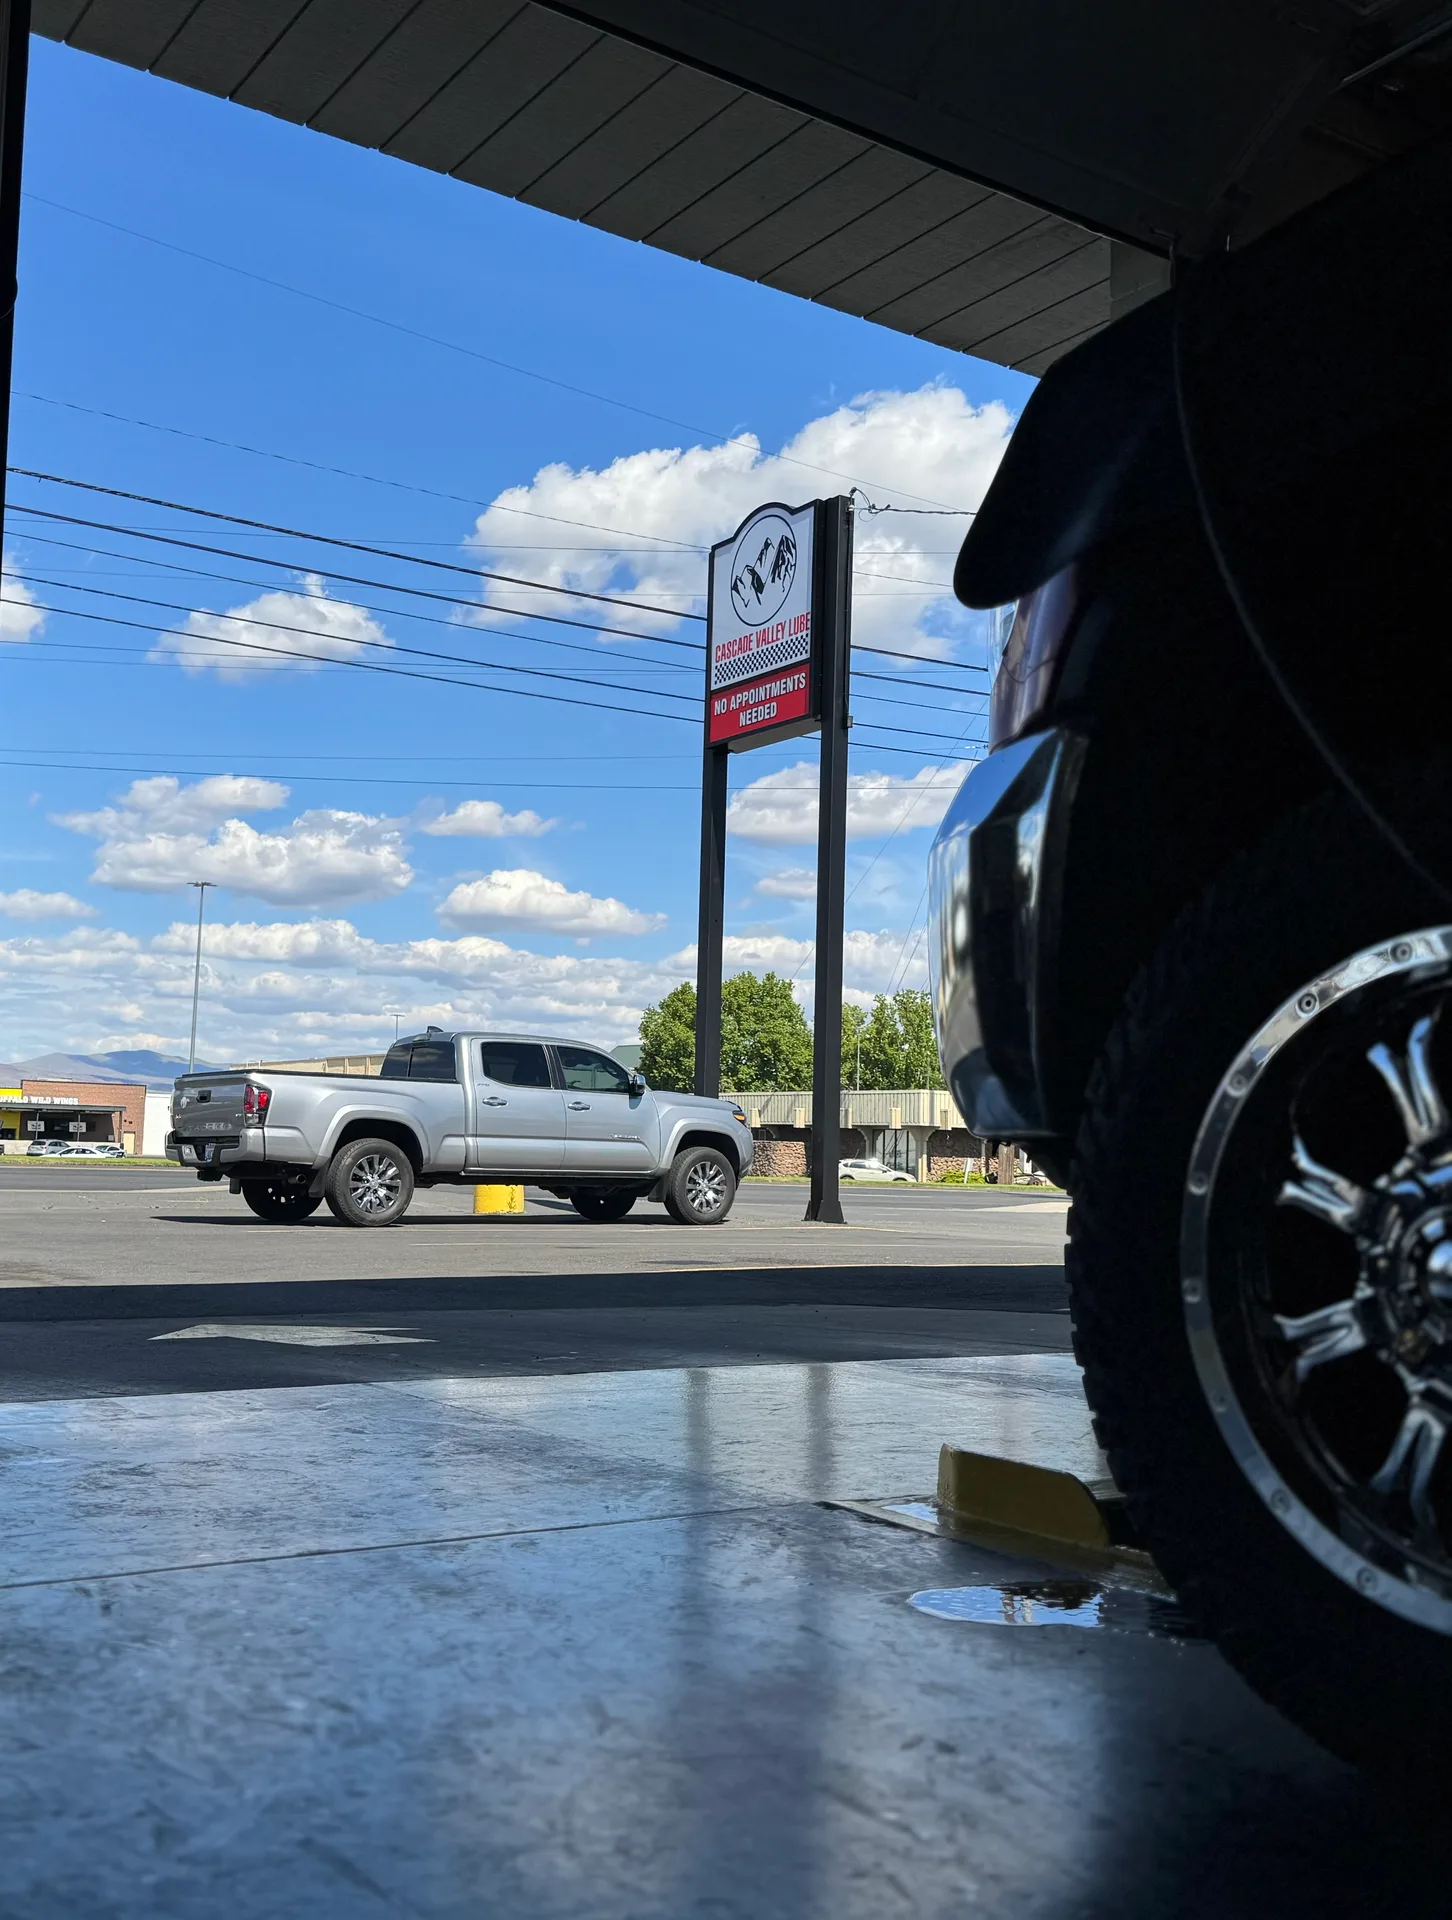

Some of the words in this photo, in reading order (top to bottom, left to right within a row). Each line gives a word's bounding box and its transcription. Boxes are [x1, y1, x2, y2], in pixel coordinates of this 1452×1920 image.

[715, 633, 754, 663] CASCADE
[755, 621, 787, 648] VALLEY
[788, 612, 811, 637] LUBE
[714, 698, 728, 716] NO
[729, 672, 806, 711] APPOINTMENTS
[739, 701, 778, 727] NEEDED
[30, 1096, 52, 1105] WILD
[53, 1097, 79, 1105] WINGS
